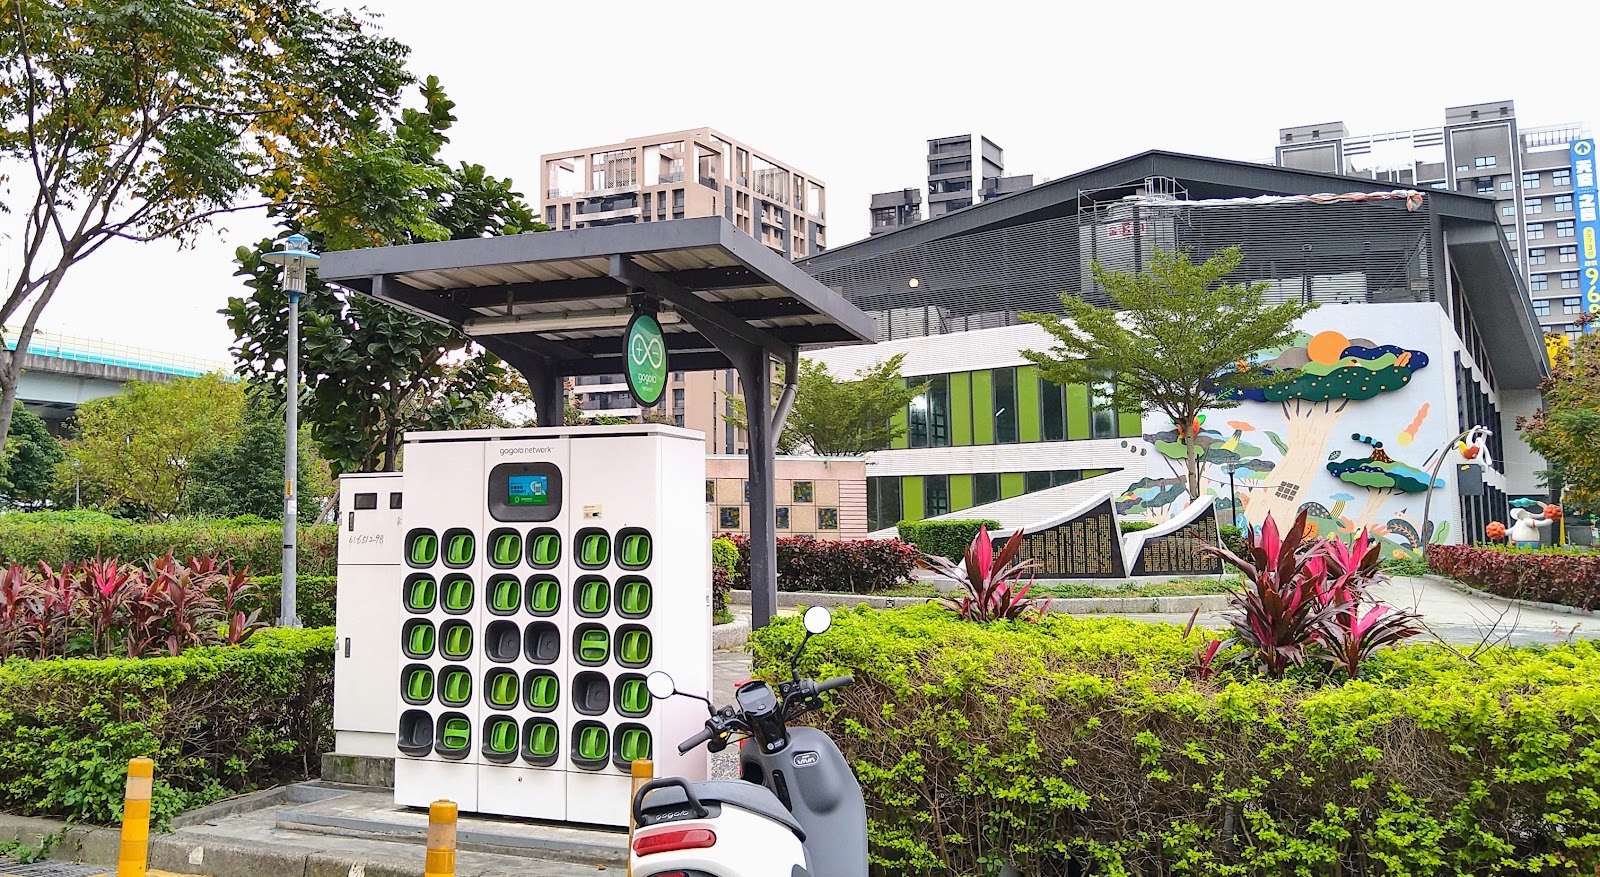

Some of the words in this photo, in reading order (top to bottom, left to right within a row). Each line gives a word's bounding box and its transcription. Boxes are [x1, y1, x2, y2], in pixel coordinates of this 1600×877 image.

[638, 373, 656, 384] gogoro
[499, 447, 524, 457] gogoro
[524, 445, 552, 454] network
[797, 757, 816, 765] VIVA
[655, 809, 689, 821] gogoro
